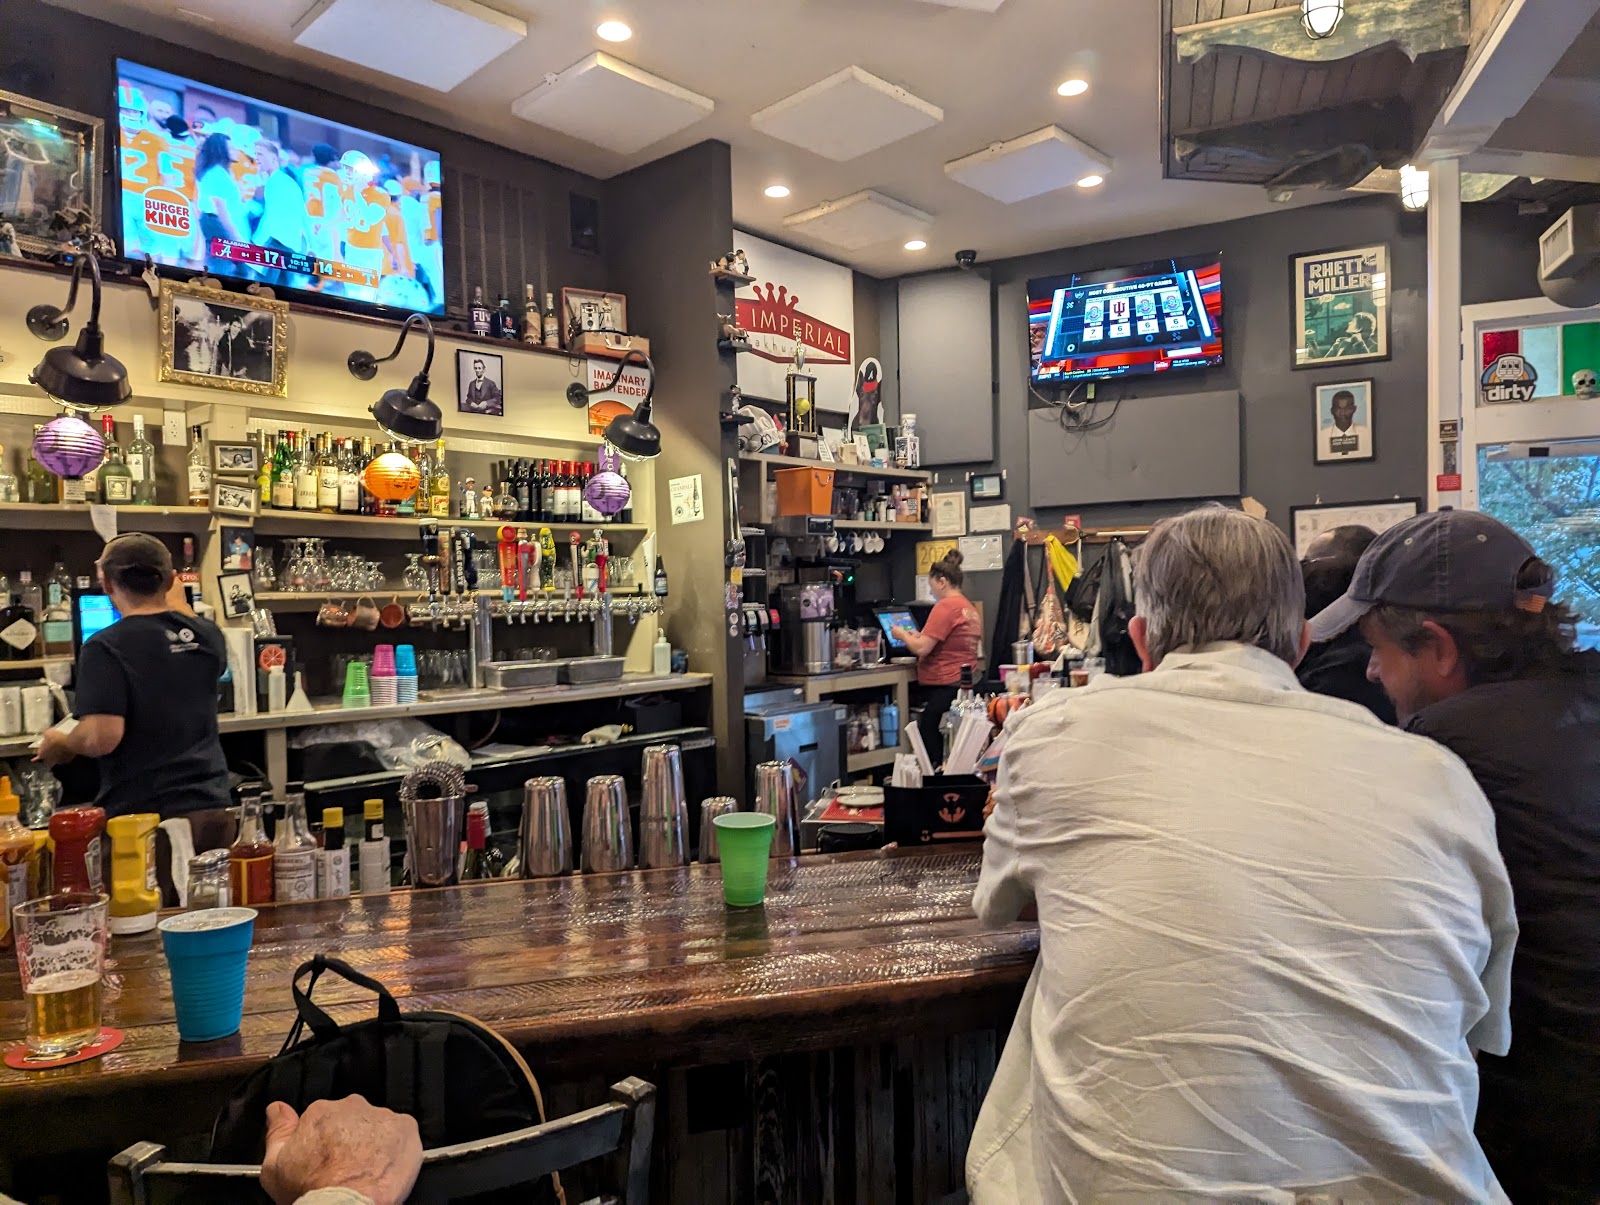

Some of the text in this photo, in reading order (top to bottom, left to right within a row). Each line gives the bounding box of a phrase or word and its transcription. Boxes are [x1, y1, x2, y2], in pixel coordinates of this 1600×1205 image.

[145, 199, 190, 217] BURGER
[145, 209, 190, 230] KING
[223, 240, 250, 249] ALABAMA
[264, 250, 279, 264] 17
[318, 261, 333, 275] 14
[1309, 258, 1363, 279] RHETT
[1308, 272, 1372, 295] MILLER
[752, 308, 845, 355] IMPERIAL
[593, 369, 646, 386] IMANARY
[1488, 383, 1534, 401] dirty
